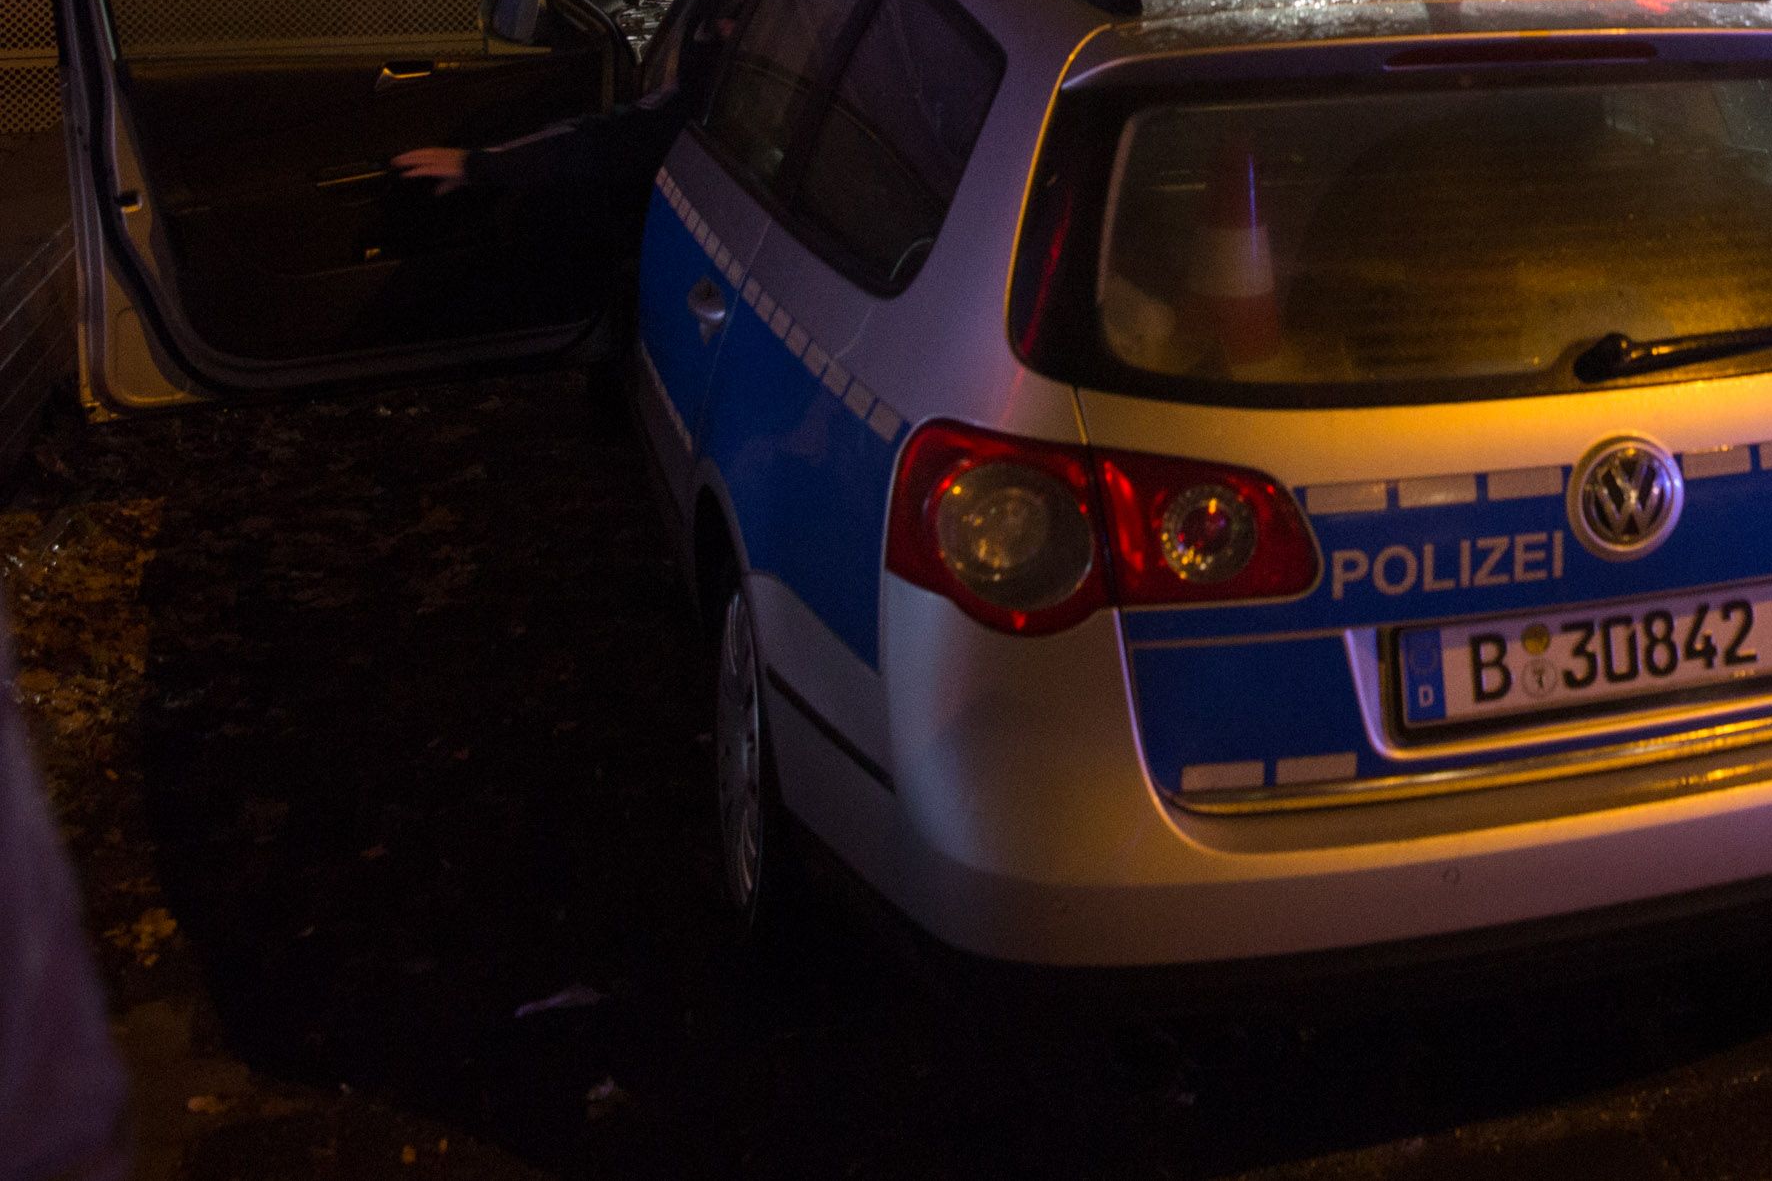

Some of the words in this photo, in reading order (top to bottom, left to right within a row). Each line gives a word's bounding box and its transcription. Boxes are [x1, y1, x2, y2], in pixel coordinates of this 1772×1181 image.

[1331, 530, 1564, 599] POLIZEI
[1418, 685, 1433, 707] D
[1469, 633, 1513, 703] B
[1561, 599, 1757, 689] 30842
